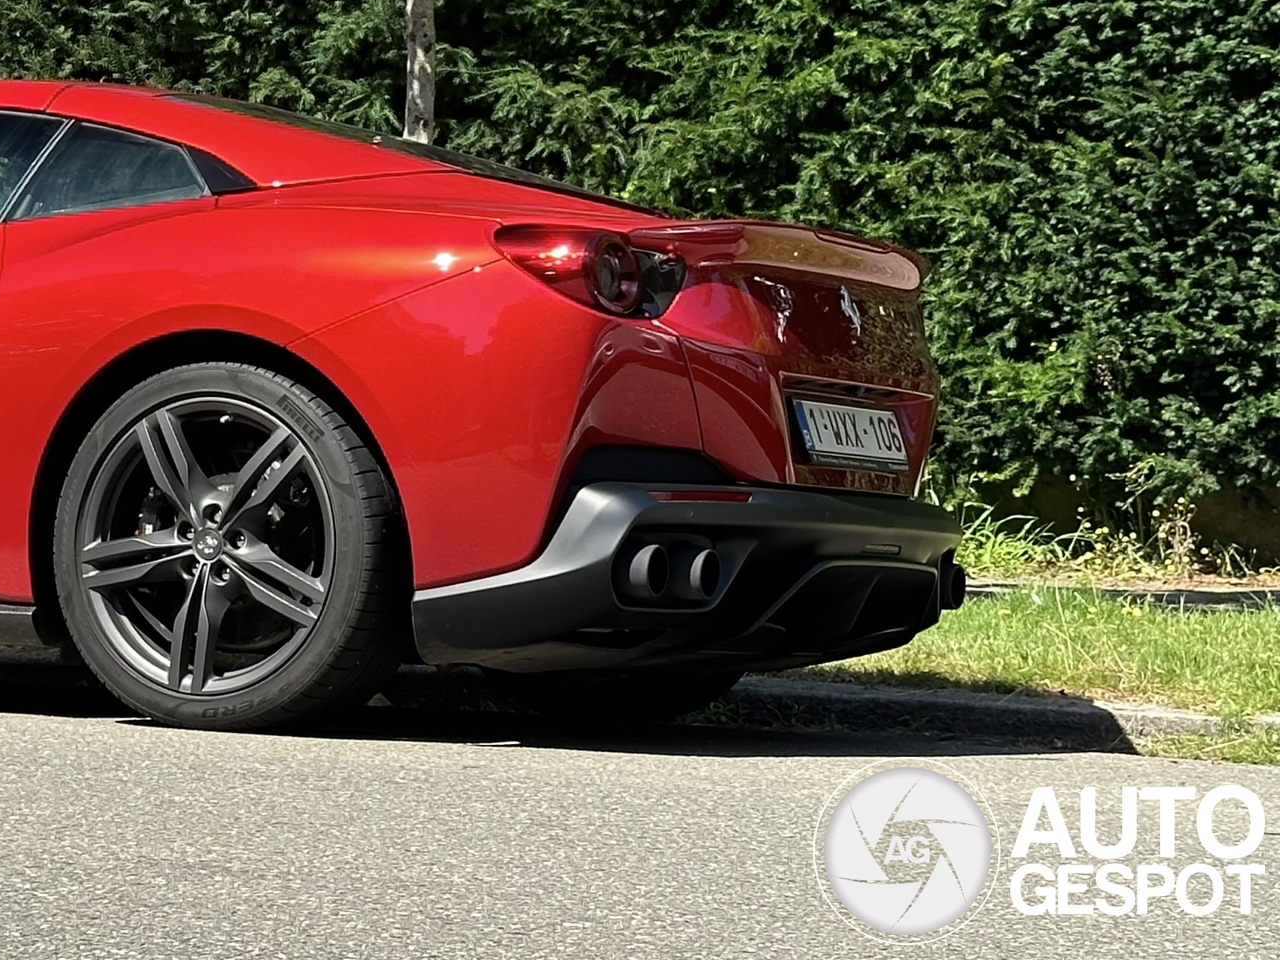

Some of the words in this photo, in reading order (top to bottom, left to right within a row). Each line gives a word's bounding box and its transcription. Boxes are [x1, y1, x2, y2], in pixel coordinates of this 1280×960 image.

[276, 395, 325, 443] PIRELLI
[809, 408, 902, 453] 1-WXX-106
[803, 429, 812, 446] B
[201, 694, 272, 718] ZERO
